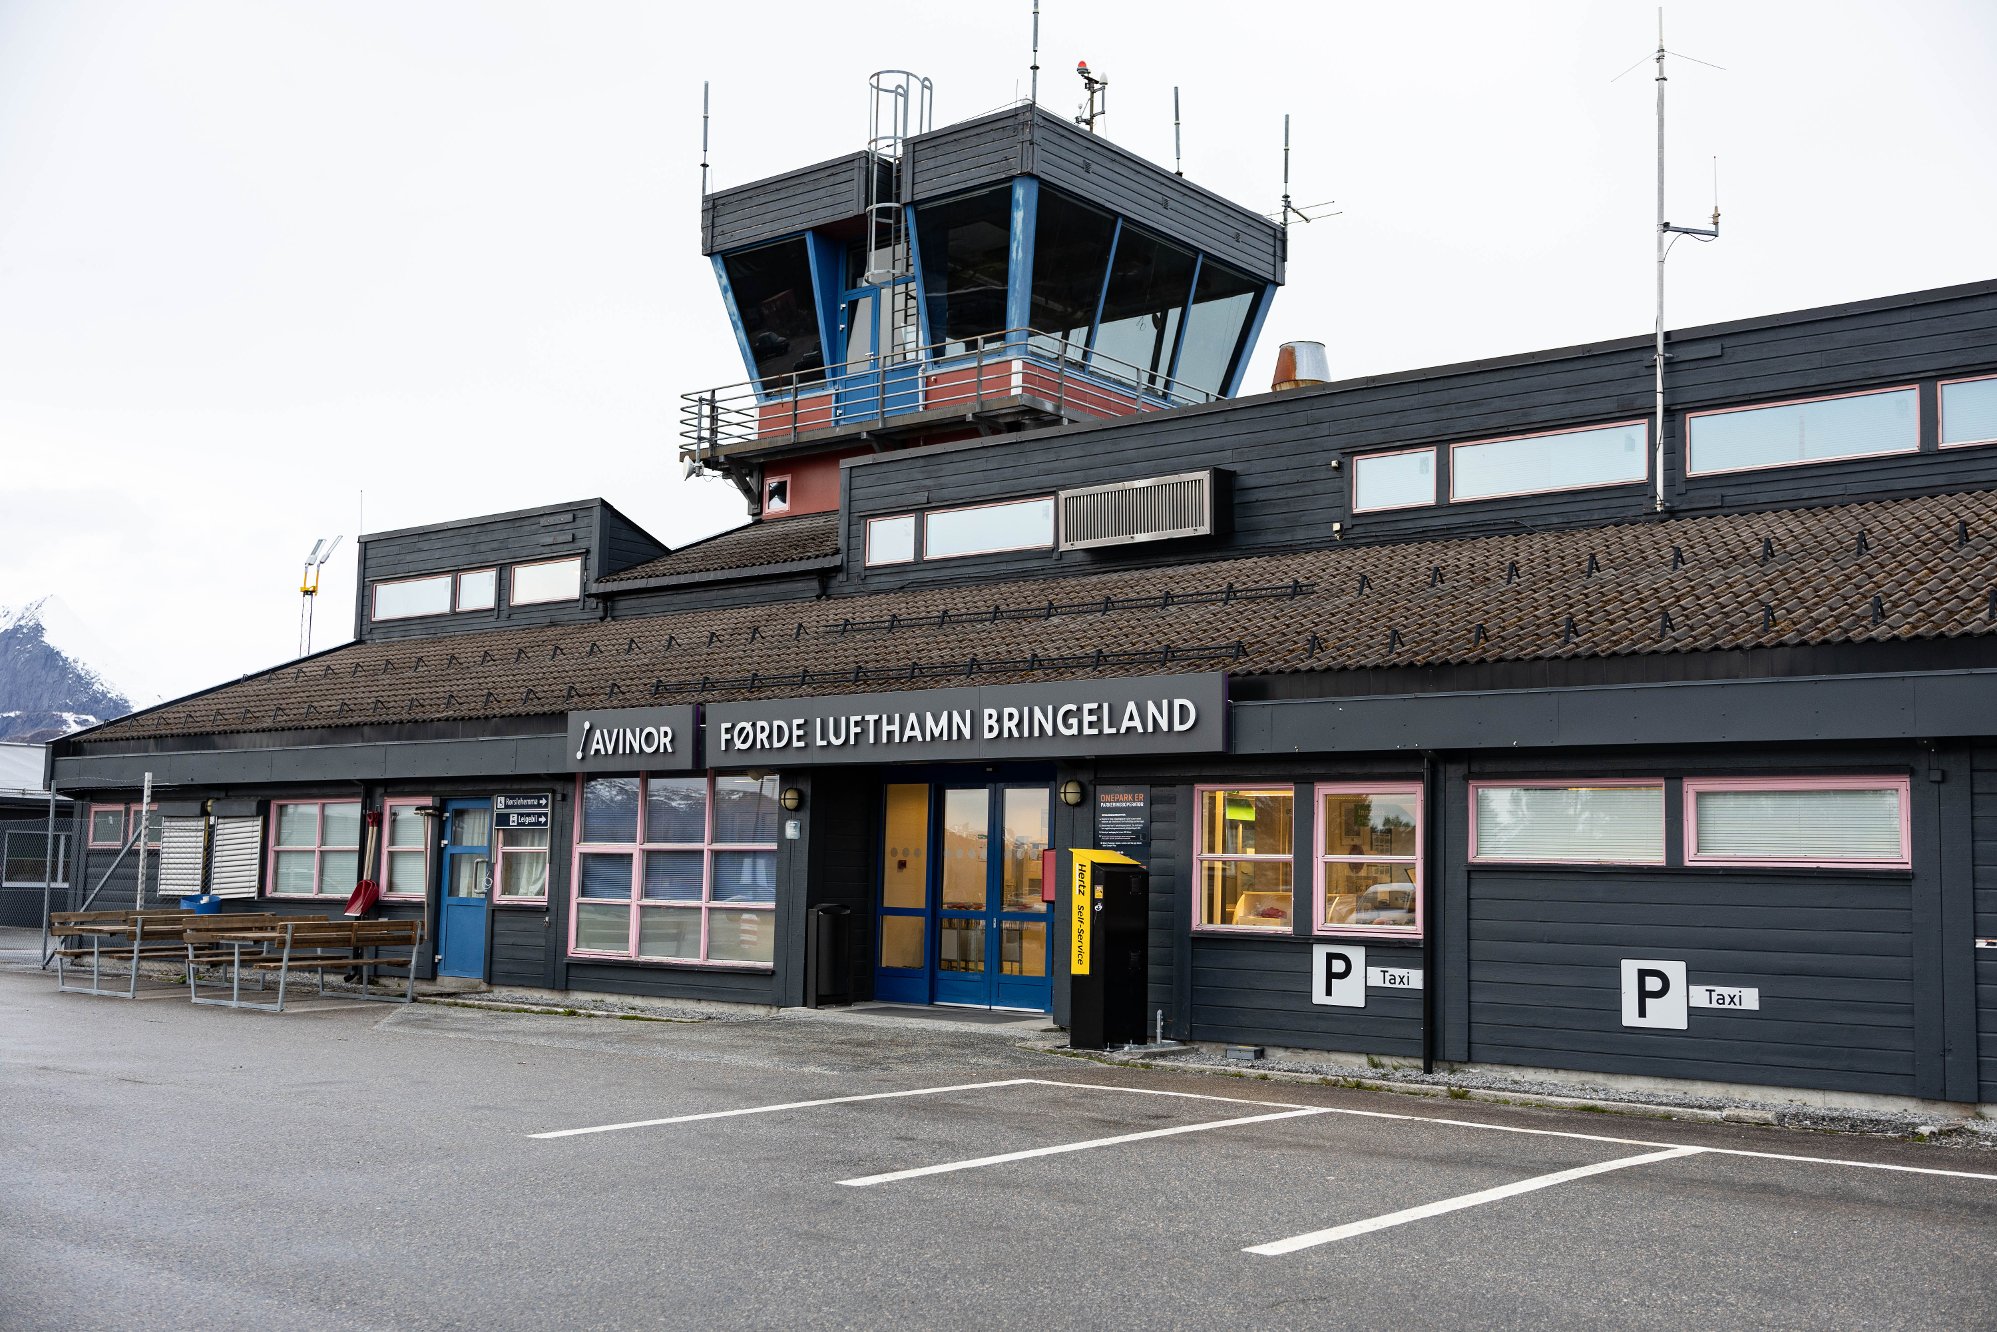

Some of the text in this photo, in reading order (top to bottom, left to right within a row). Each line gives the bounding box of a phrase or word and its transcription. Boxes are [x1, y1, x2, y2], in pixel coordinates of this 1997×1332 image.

[590, 726, 673, 756] AVINOR
[720, 698, 1196, 751] FØRDE LUFTHAMN BRINGELAND
[1100, 793, 1144, 801] ONEPARK ER
[1077, 863, 1086, 965] Hertz Self-Service
[1325, 951, 1352, 997] P
[1380, 970, 1410, 986] Taxi
[1637, 968, 1670, 1018] P
[1705, 988, 1742, 1007] Taxi
